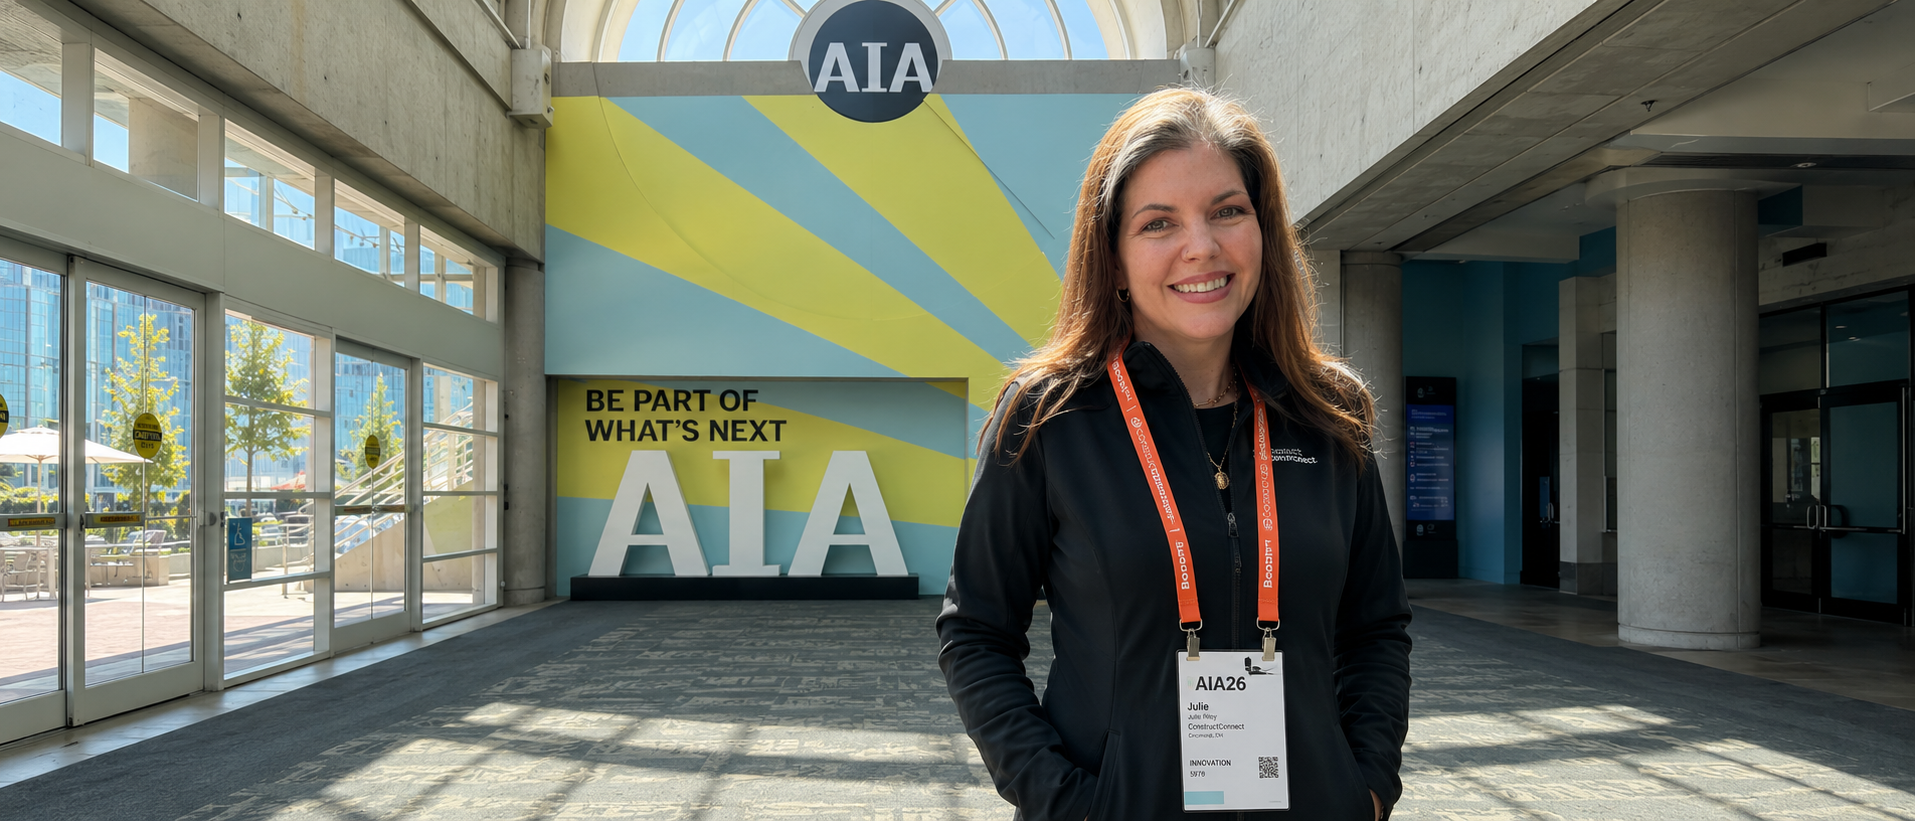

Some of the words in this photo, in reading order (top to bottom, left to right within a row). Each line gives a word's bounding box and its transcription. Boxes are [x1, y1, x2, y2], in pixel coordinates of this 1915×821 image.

[814, 42, 934, 93] AIA
[586, 389, 624, 412] BE
[634, 389, 712, 412] PART
[719, 389, 759, 412] OF
[585, 419, 700, 442] WHAT’S
[709, 419, 787, 442] NEXT
[588, 450, 909, 576] AIA
[1195, 676, 1247, 691] AIA26
[1187, 702, 1209, 711] Julie
[1188, 723, 1245, 731] ConstructConnect
[1189, 759, 1232, 767] INNOVATION
